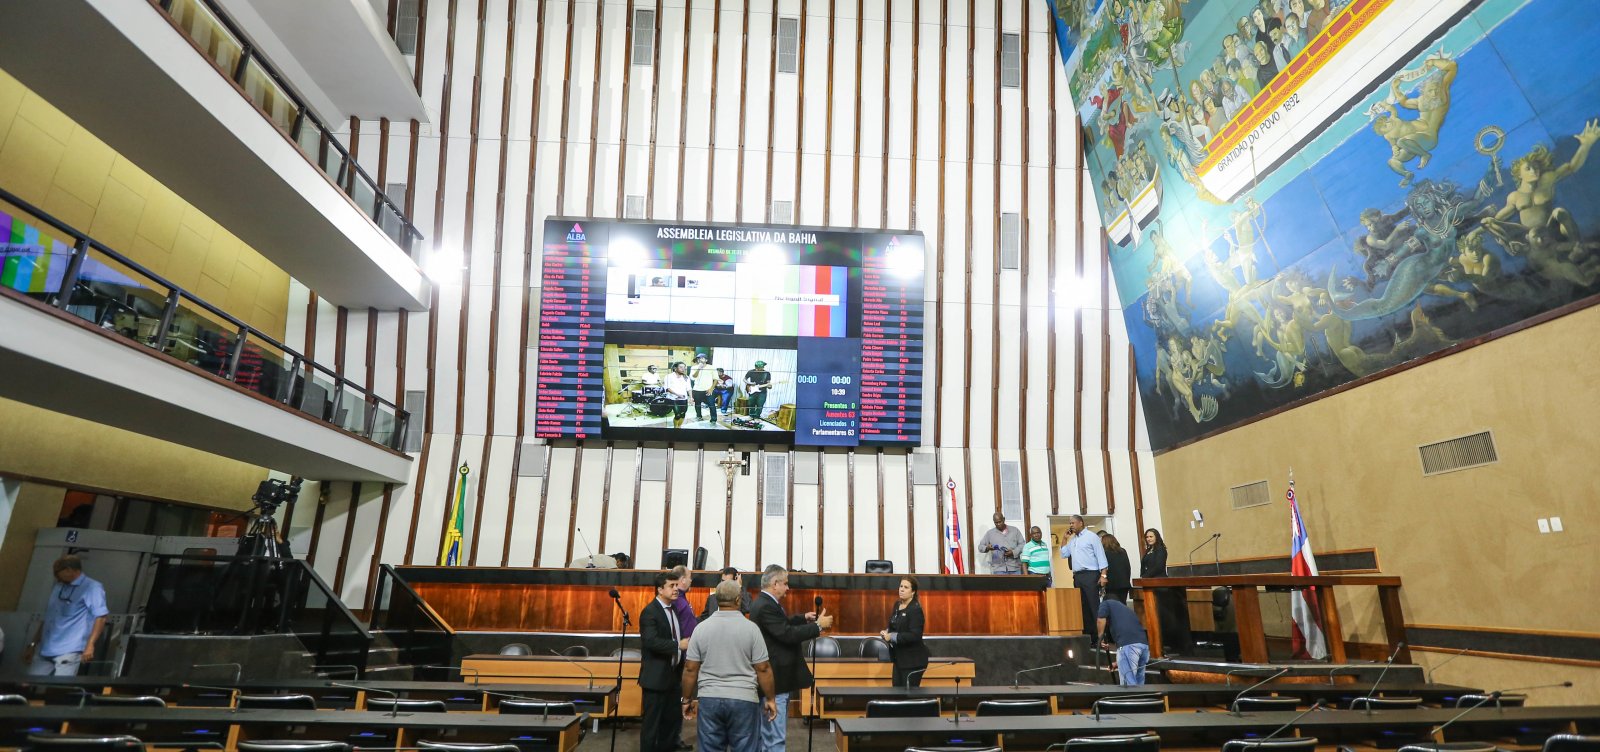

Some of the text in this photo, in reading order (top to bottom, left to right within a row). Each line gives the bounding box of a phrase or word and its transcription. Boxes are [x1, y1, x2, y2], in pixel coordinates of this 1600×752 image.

[1248, 130, 1260, 145] DO
[1259, 111, 1281, 134] POVO
[1283, 93, 1300, 112] 1892
[566, 232, 587, 241] ALBA
[656, 227, 817, 245] ASSEMBLEIA LEGISLATIVA DA BAHIA
[798, 374, 817, 384] 00:00
[831, 376, 851, 384] 00:00
